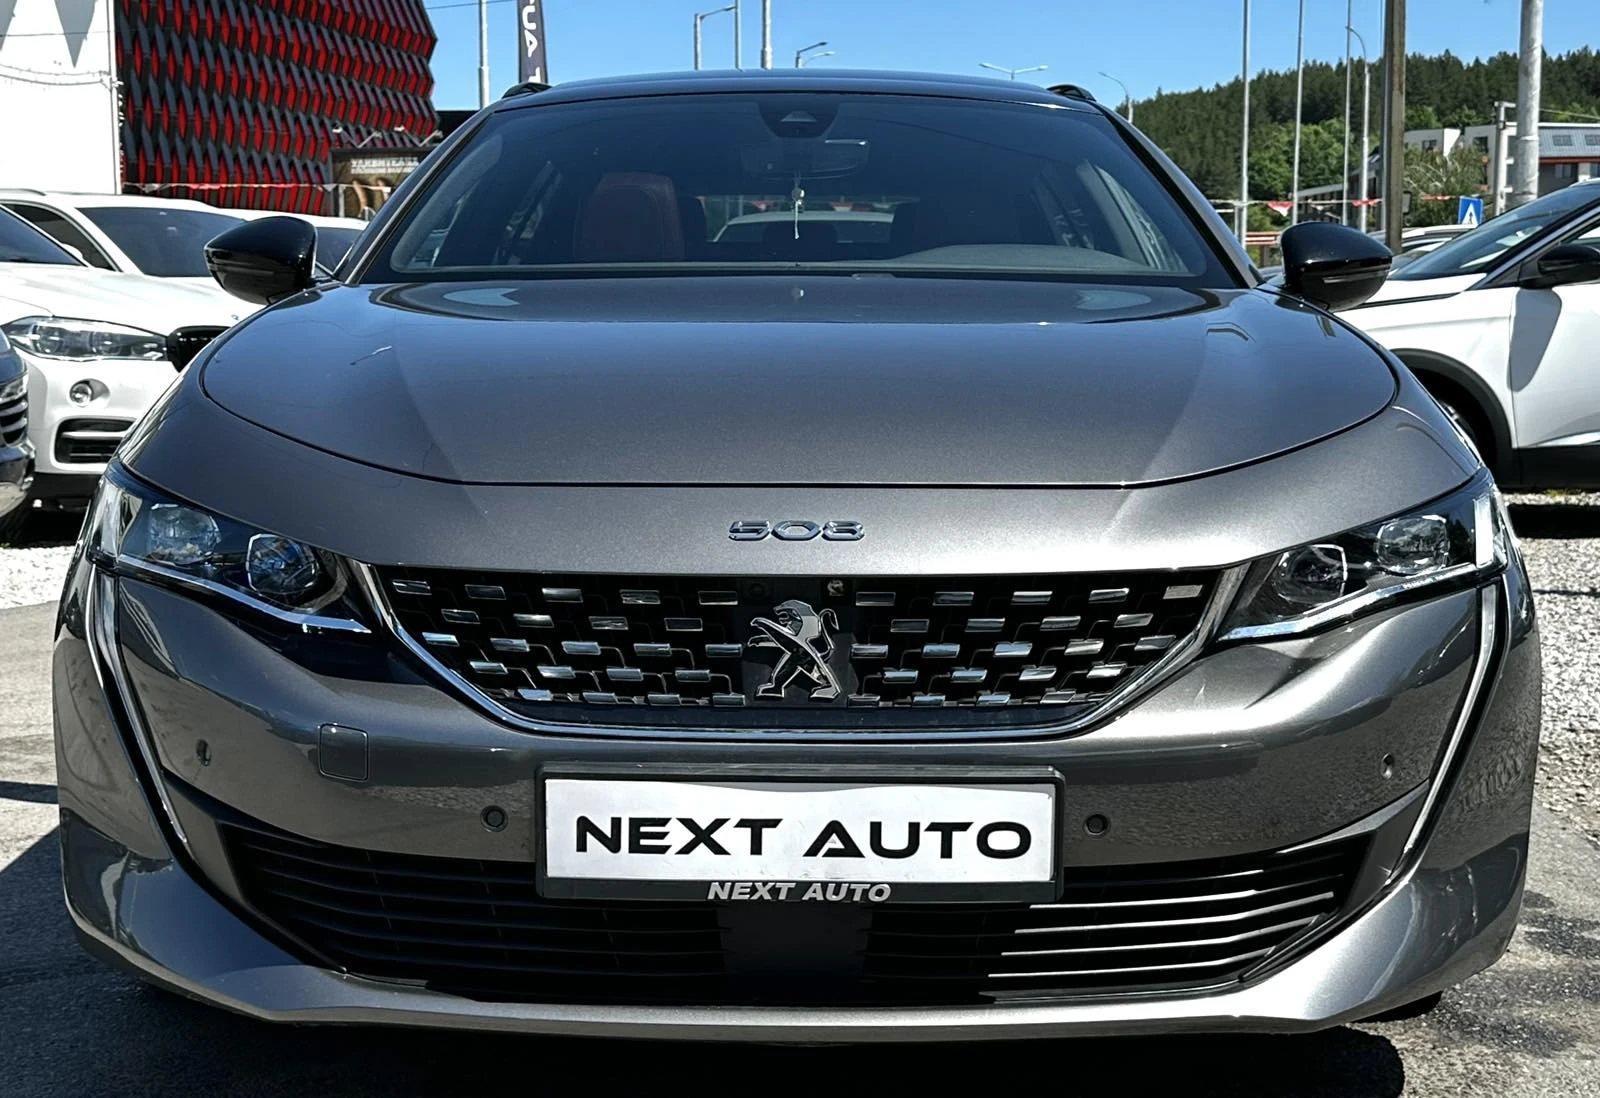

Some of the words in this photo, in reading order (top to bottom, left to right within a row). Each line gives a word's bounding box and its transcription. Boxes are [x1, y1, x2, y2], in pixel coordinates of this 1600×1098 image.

[522, 0, 538, 58] UA
[728, 520, 866, 542] 508
[575, 815, 784, 856] NEXT
[802, 819, 1033, 860] AUTO
[706, 881, 796, 901] NEXT
[801, 883, 892, 902] AUTO
